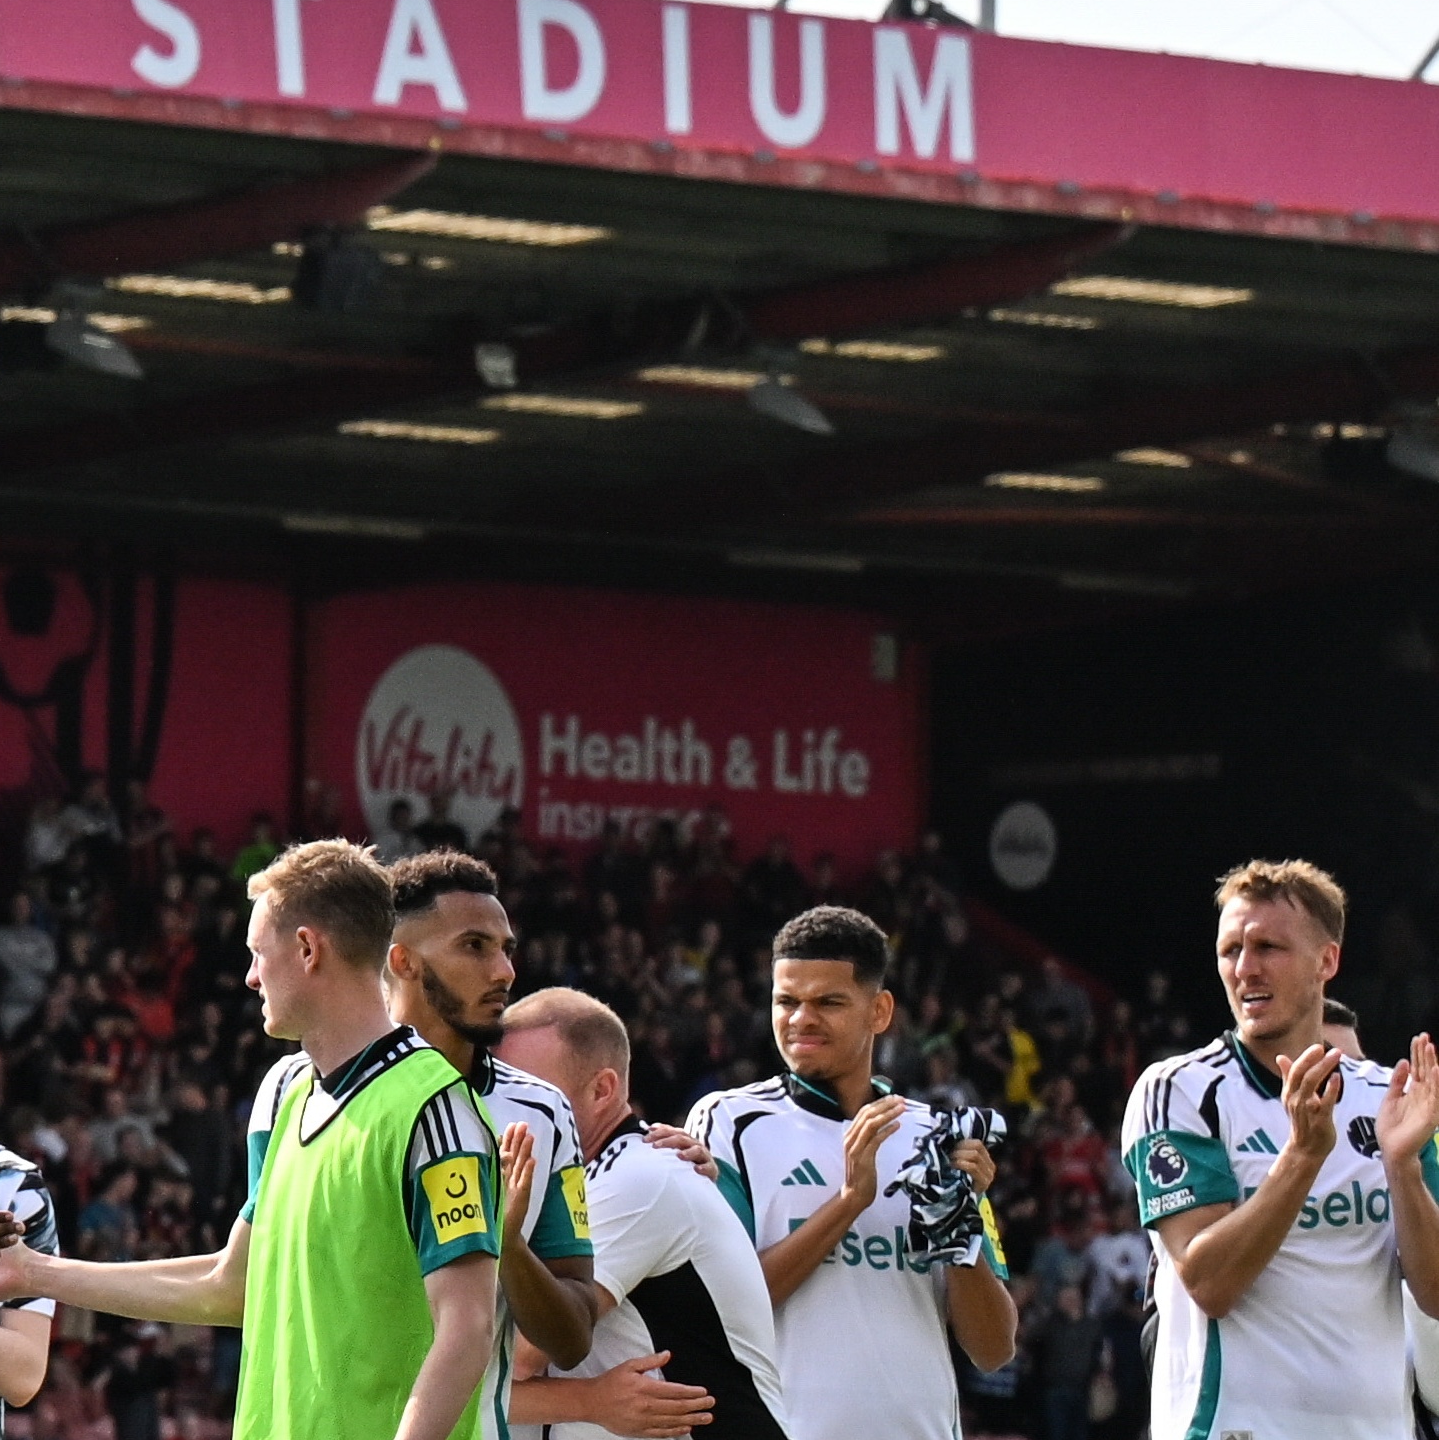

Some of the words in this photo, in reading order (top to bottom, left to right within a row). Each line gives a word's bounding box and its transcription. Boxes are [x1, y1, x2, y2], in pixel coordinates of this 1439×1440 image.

[539, 711, 713, 787] Health
[724, 735, 758, 791] &
[772, 727, 872, 798] Life
[436, 1203, 482, 1229] noon
[1298, 1180, 1391, 1229] sela
